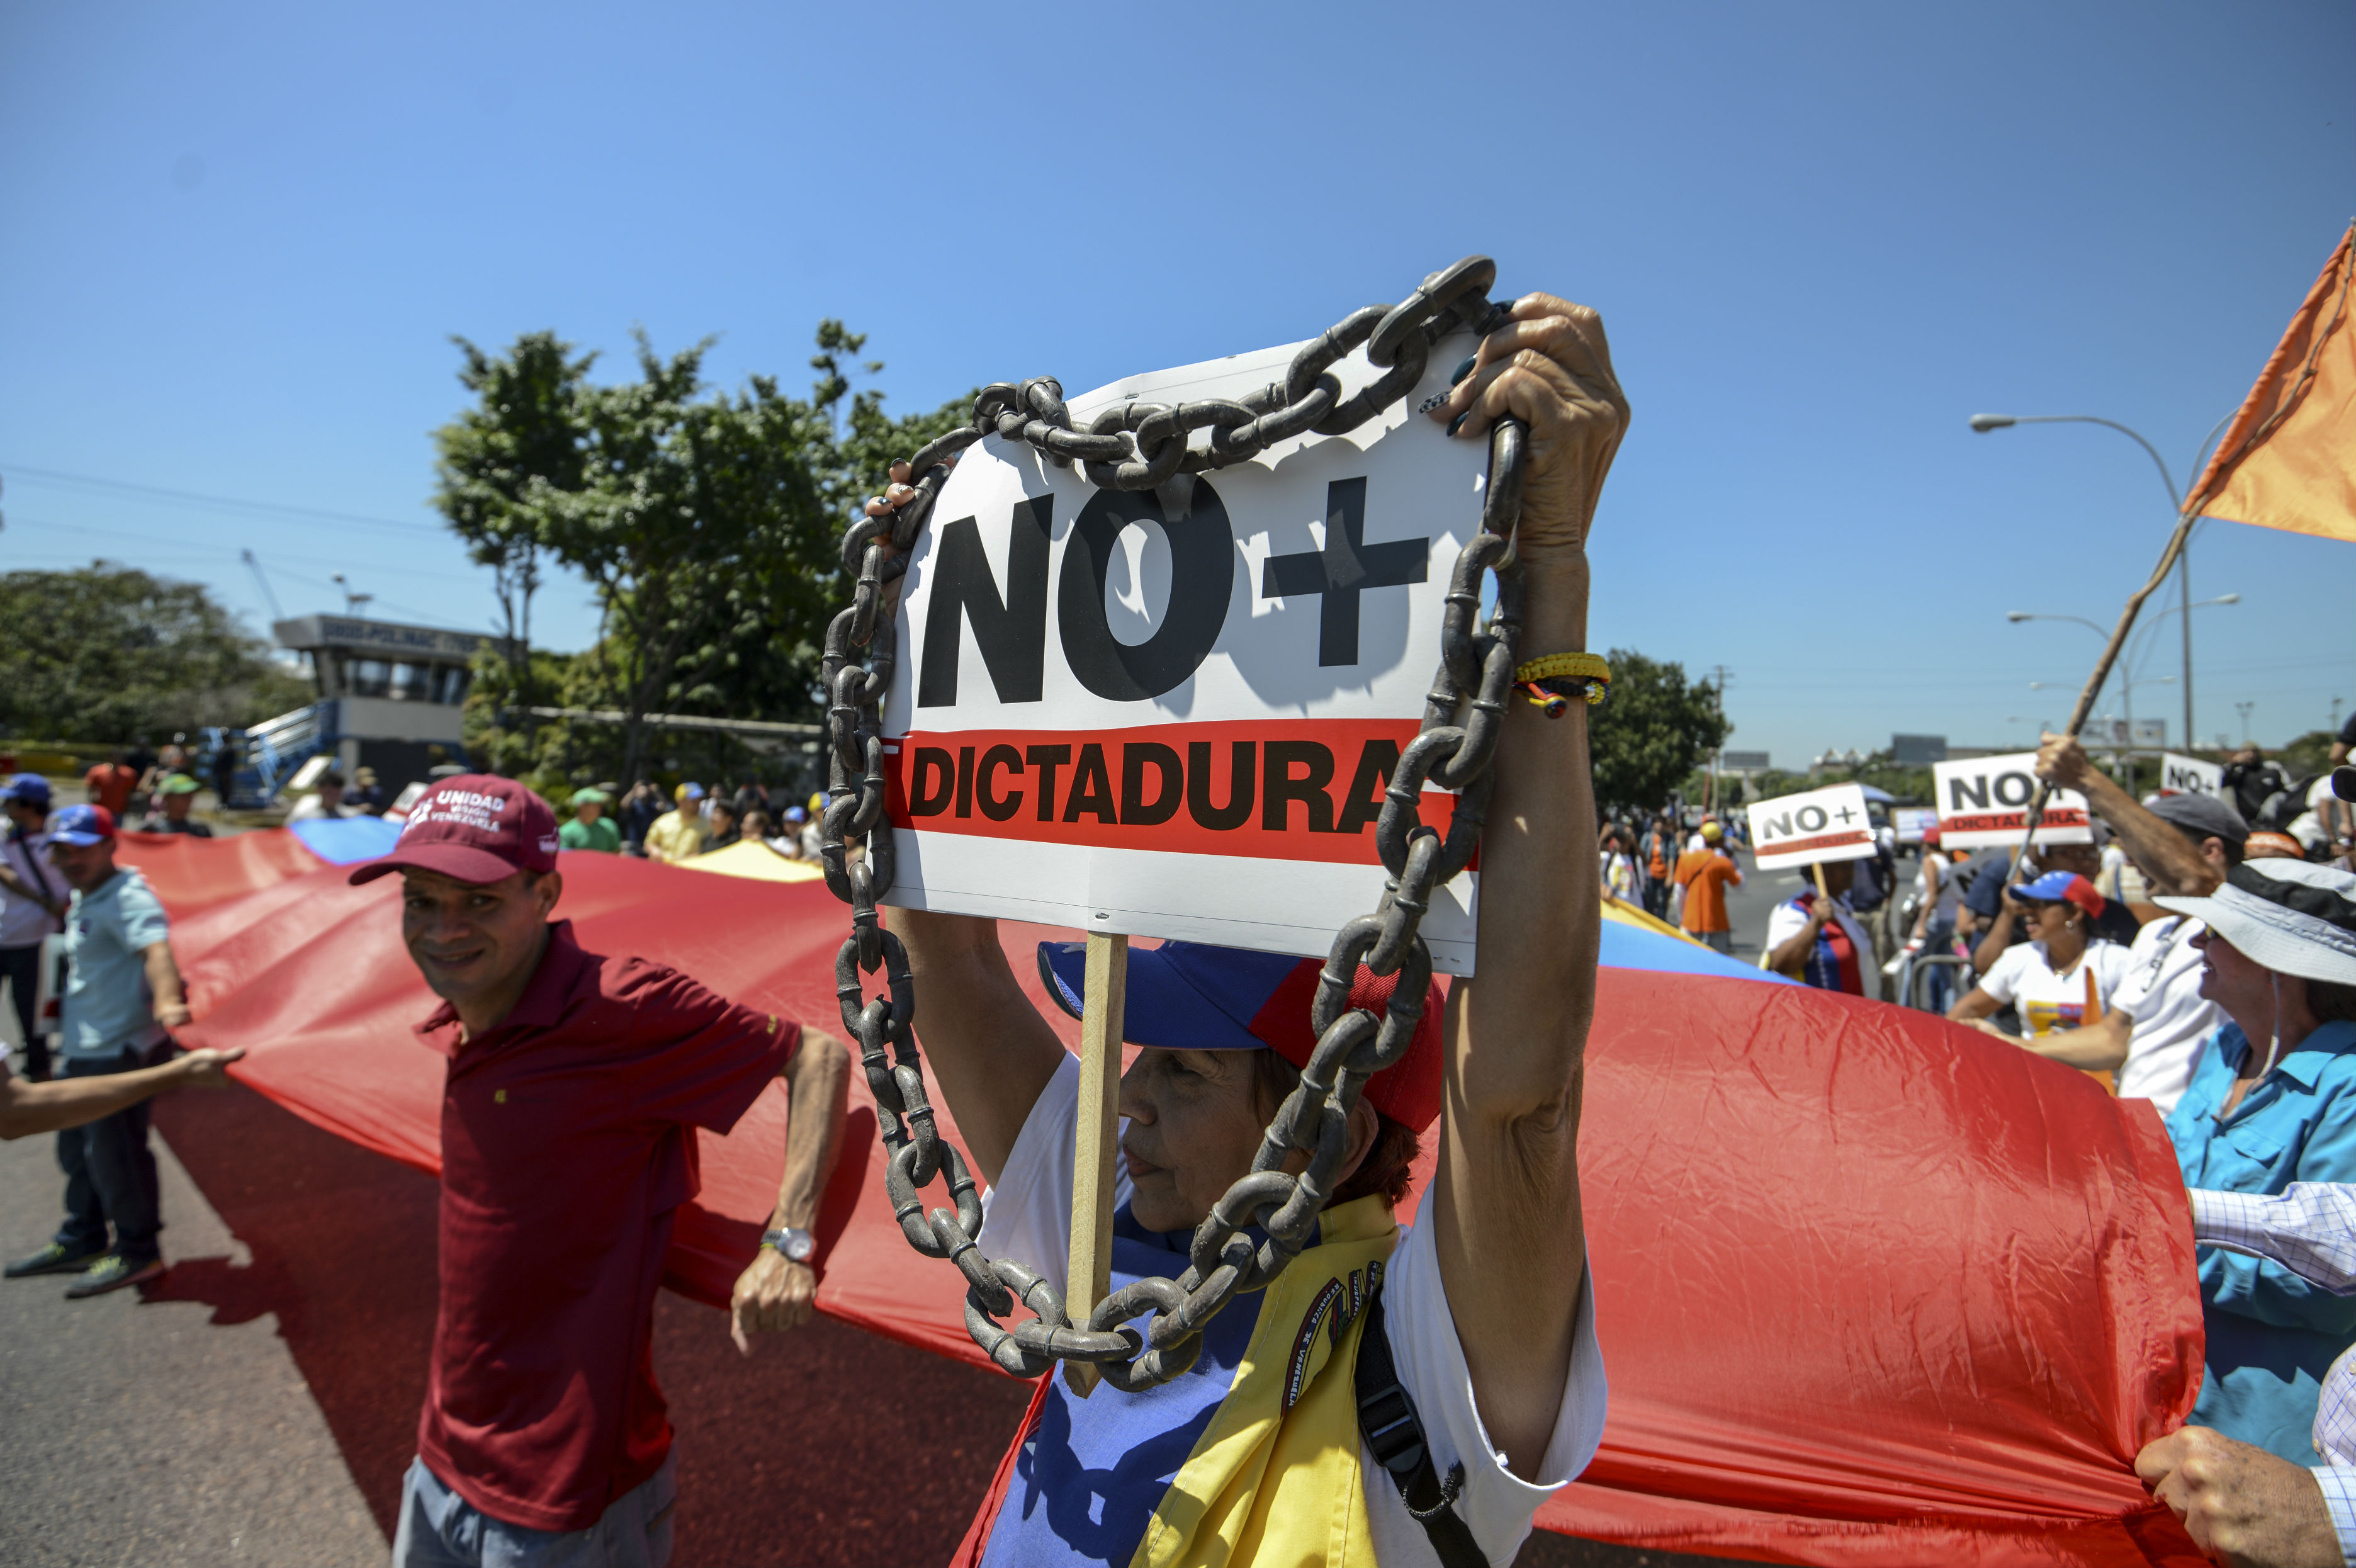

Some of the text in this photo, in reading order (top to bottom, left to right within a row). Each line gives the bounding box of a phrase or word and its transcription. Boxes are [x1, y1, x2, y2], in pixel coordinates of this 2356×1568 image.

[909, 739, 1421, 834] DICTADURA
[436, 790, 505, 812] UNIDAD
[431, 811, 500, 833] VENEZUELA
[1954, 811, 2077, 830] DICTARA
[1288, 1350, 1306, 1406] VENEZUELA
